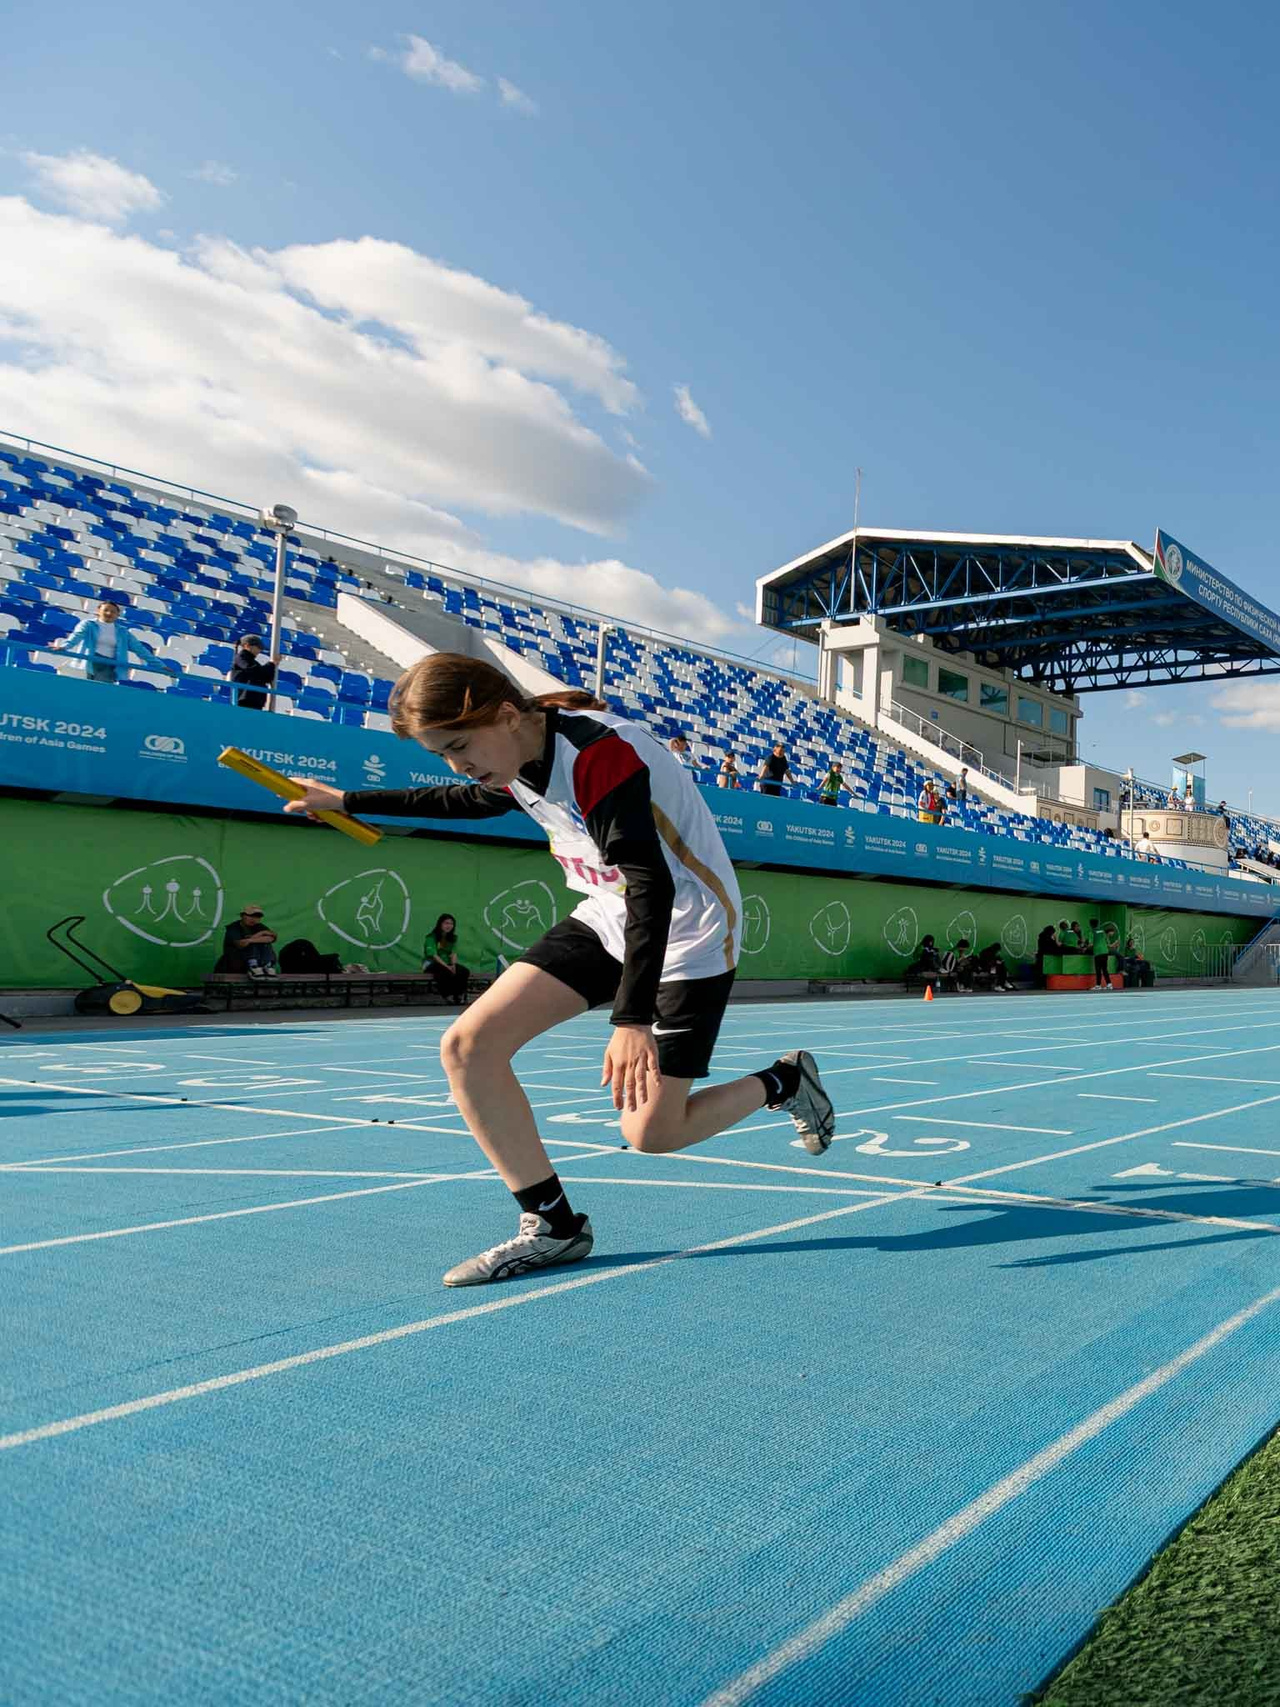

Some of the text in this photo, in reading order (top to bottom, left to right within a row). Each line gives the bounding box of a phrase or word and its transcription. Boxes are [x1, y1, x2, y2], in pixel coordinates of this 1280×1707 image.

[1186, 560, 1234, 601] МИНИСТЕРСТВО
[1198, 584, 1222, 608] СПОРТУ
[54, 721, 107, 740] 2024
[25, 735, 38, 744] of
[39, 737, 65, 748] Asia
[66, 740, 107, 753] Games
[297, 755, 338, 771] 2024
[408, 771, 468, 786] YAKUTSK
[723, 815, 743, 826] 2024
[786, 824, 817, 837] YAKUTSK
[817, 829, 835, 838] 2024
